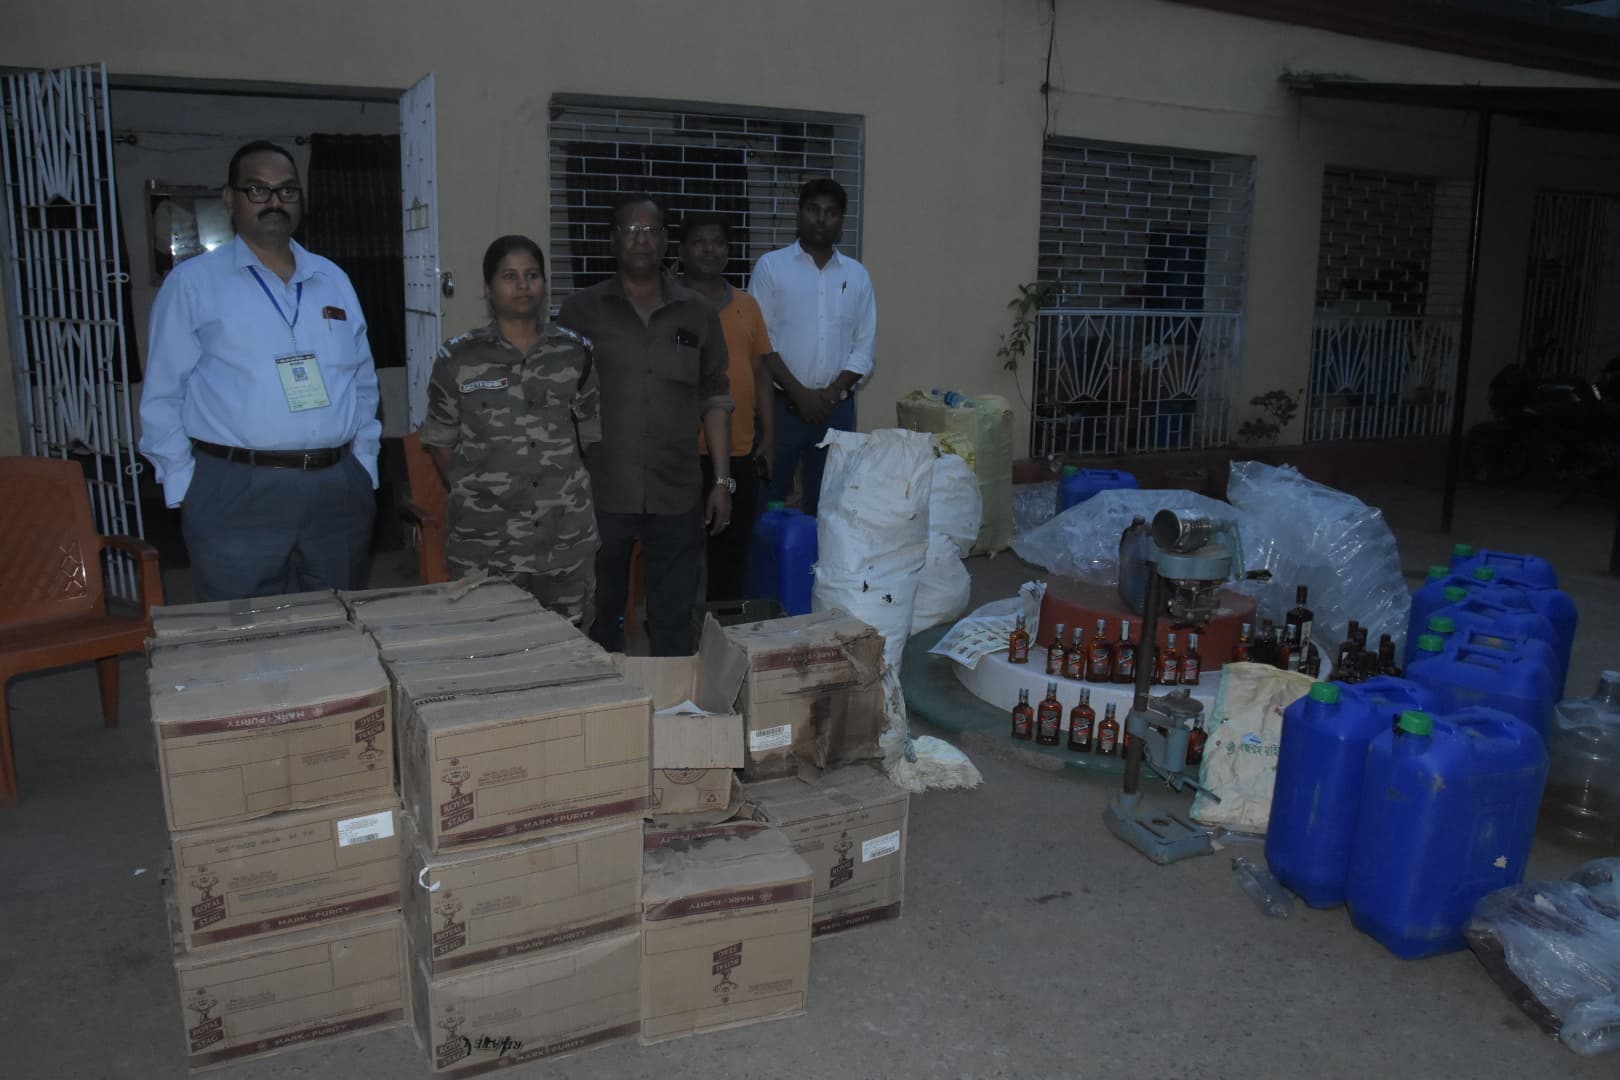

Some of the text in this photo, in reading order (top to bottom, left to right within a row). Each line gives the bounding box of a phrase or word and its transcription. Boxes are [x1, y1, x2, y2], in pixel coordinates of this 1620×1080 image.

[227, 710, 305, 728] MARK PURITY
[359, 723, 385, 741] ROYAL
[443, 796, 470, 814] ROYAL
[447, 813, 469, 828] STAG
[524, 817, 553, 828] MARK
[560, 810, 595, 821] PURITY
[194, 898, 219, 913] ROYAL
[688, 899, 721, 909] PURITY
[727, 895, 754, 903] MARK
[199, 911, 221, 926] STAG
[277, 914, 306, 925] MARK
[313, 905, 350, 918] PURITY
[435, 926, 462, 942] ROYAL
[515, 930, 586, 952] MARK PURITY
[193, 1021, 217, 1037] ROYAL
[274, 1023, 348, 1045] MARK PURITY
[196, 1034, 218, 1049] STAG
[517, 1040, 586, 1061] MARK PURITY
